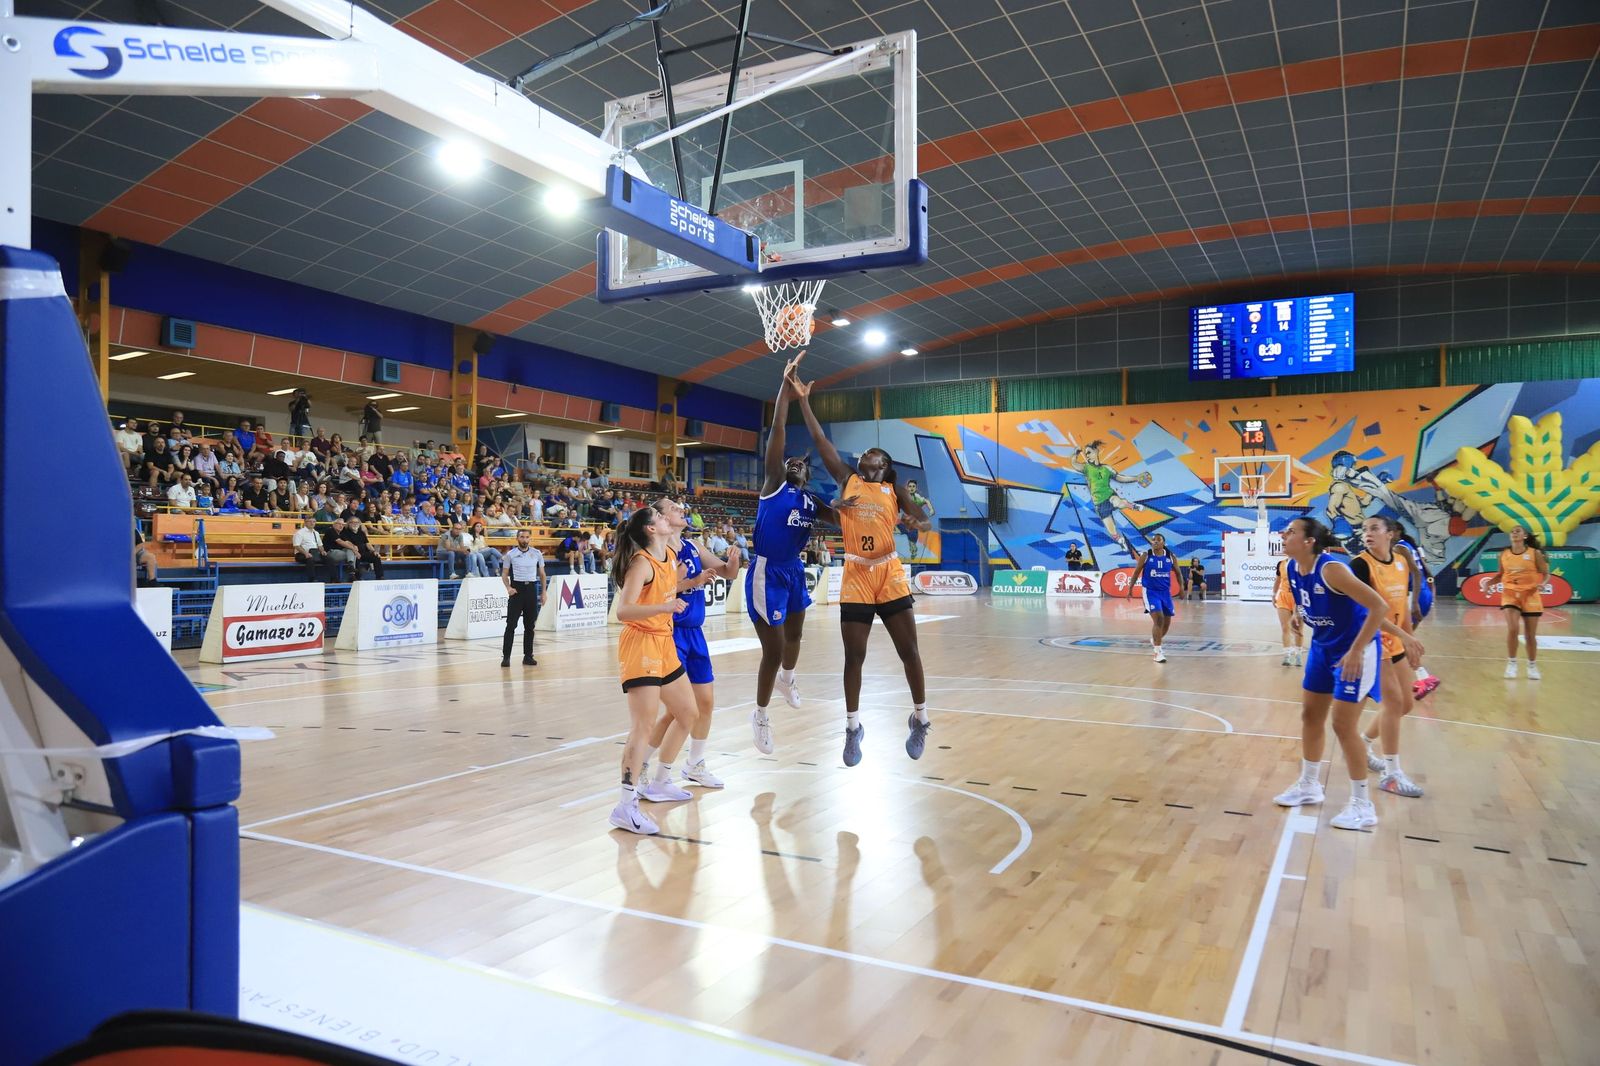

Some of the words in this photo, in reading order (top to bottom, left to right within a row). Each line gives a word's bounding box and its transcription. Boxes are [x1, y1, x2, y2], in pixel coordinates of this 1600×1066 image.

[124, 37, 246, 64] Schelde
[670, 198, 715, 231] Schelde
[670, 213, 715, 244] Sports
[1250, 323, 1258, 334] 2
[1278, 320, 1290, 332] 14
[1242, 431, 1264, 443] 1.8
[861, 535, 875, 551] 23
[992, 585, 1014, 594] CAJA
[1014, 585, 1045, 594] RURAL
[246, 592, 305, 613] Muebles
[469, 593, 509, 610] RESTAUR
[382, 603, 418, 622] C&M
[236, 624, 294, 646] Gamazo
[298, 621, 316, 638] 22
